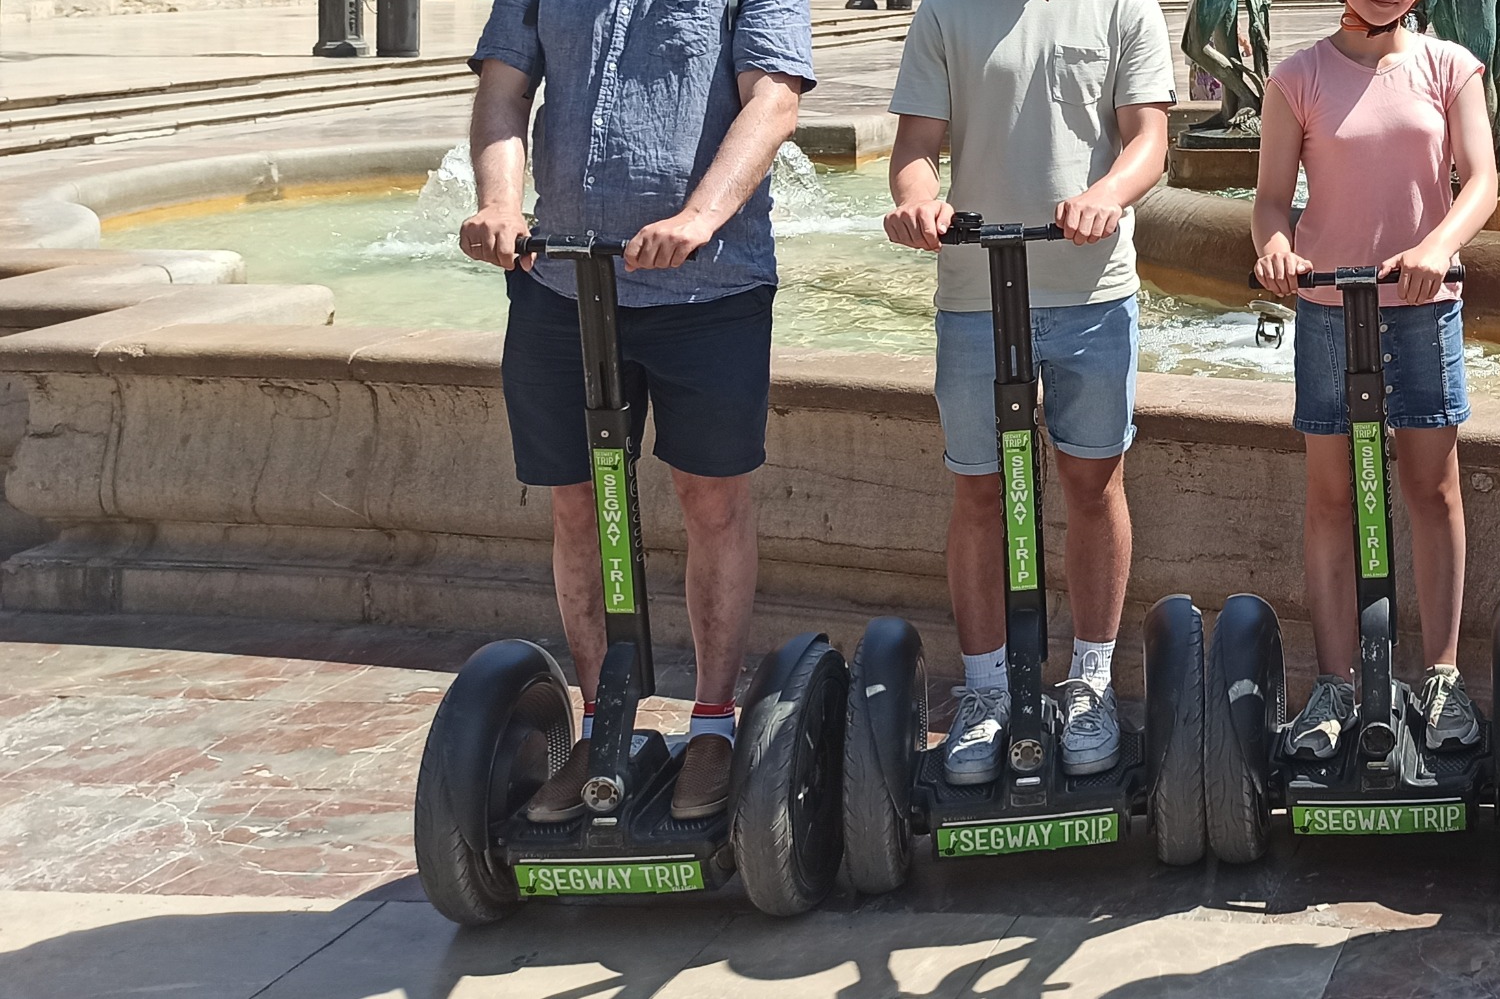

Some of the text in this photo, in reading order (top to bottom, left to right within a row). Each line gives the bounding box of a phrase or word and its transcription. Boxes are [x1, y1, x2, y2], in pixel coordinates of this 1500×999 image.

[1005, 439, 1021, 448] TRIP
[1355, 430, 1371, 438] TRIP
[596, 457, 614, 465] TRIP
[1360, 446, 1378, 514] SEGWAY
[603, 474, 622, 546] SEGWAY
[1010, 456, 1028, 525] SEGWAY
[1015, 536, 1029, 583] TRIP
[1366, 525, 1380, 571] TRIP
[609, 558, 624, 606] TRIP
[959, 817, 1112, 852] SEGWAY TRIP
[1314, 806, 1460, 831] SEGWAY TRIP
[538, 864, 695, 890] SEGWAY TRIP
